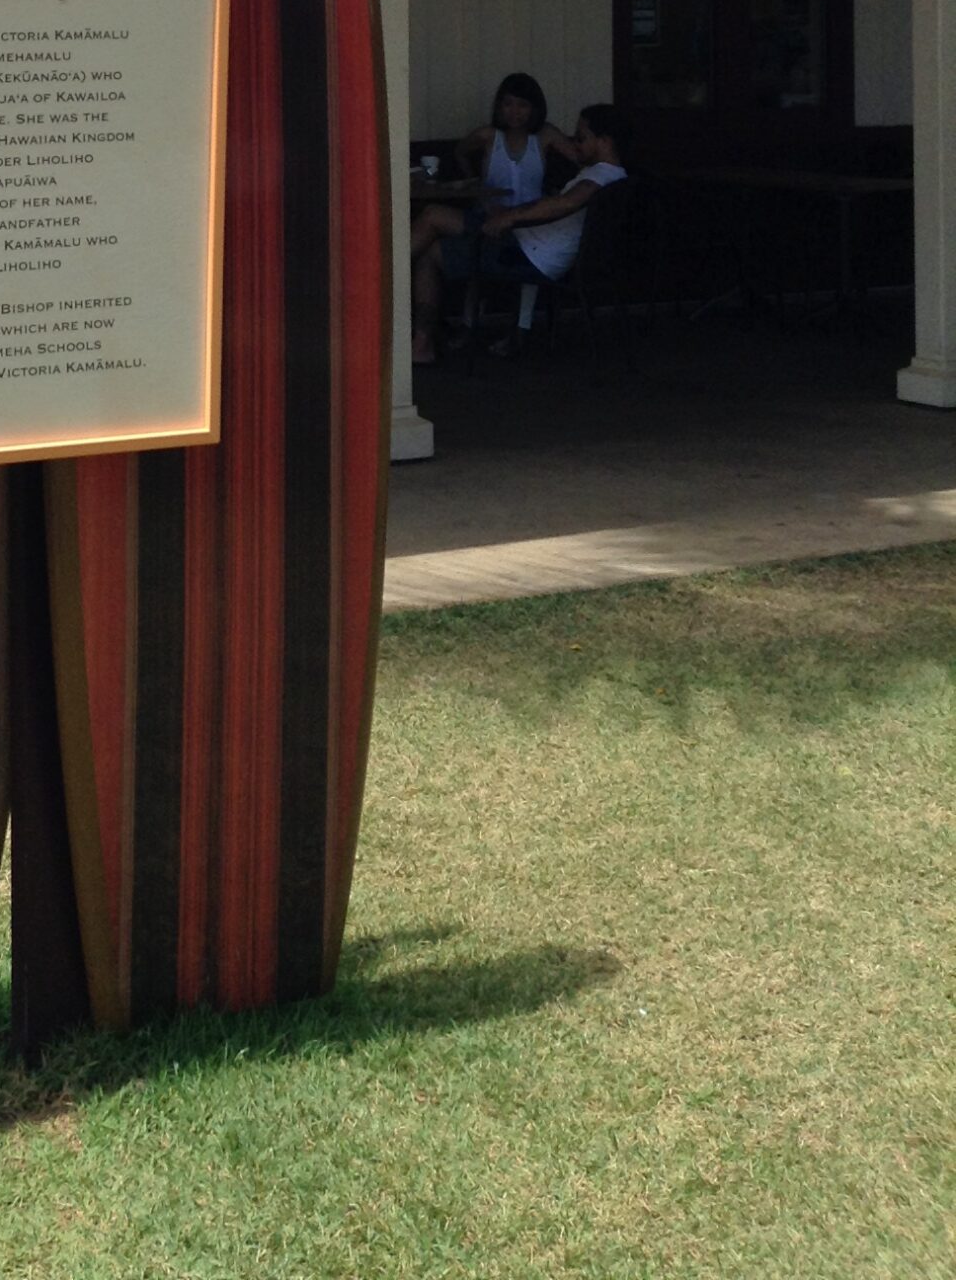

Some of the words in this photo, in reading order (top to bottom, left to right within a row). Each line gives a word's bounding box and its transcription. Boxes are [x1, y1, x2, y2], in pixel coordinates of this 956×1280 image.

[90, 70, 123, 81] WHO
[32, 93, 52, 104] OF
[56, 91, 127, 103] KAWAILOA
[15, 113, 45, 125] SHE
[48, 112, 78, 124] WAS
[82, 111, 109, 123] THE
[71, 131, 135, 144] KINGDOM
[26, 153, 94, 166] LIHOLIHO
[22, 197, 51, 208] HER
[55, 194, 98, 206] NAME,
[85, 234, 119, 247] WHO
[0, 301, 55, 316] BISHOP
[58, 296, 133, 312] INHERITED
[0, 323, 47, 336] WHICH
[51, 320, 79, 332] ARE
[83, 318, 116, 330] NOW
[36, 339, 102, 355] SCHOOLS
